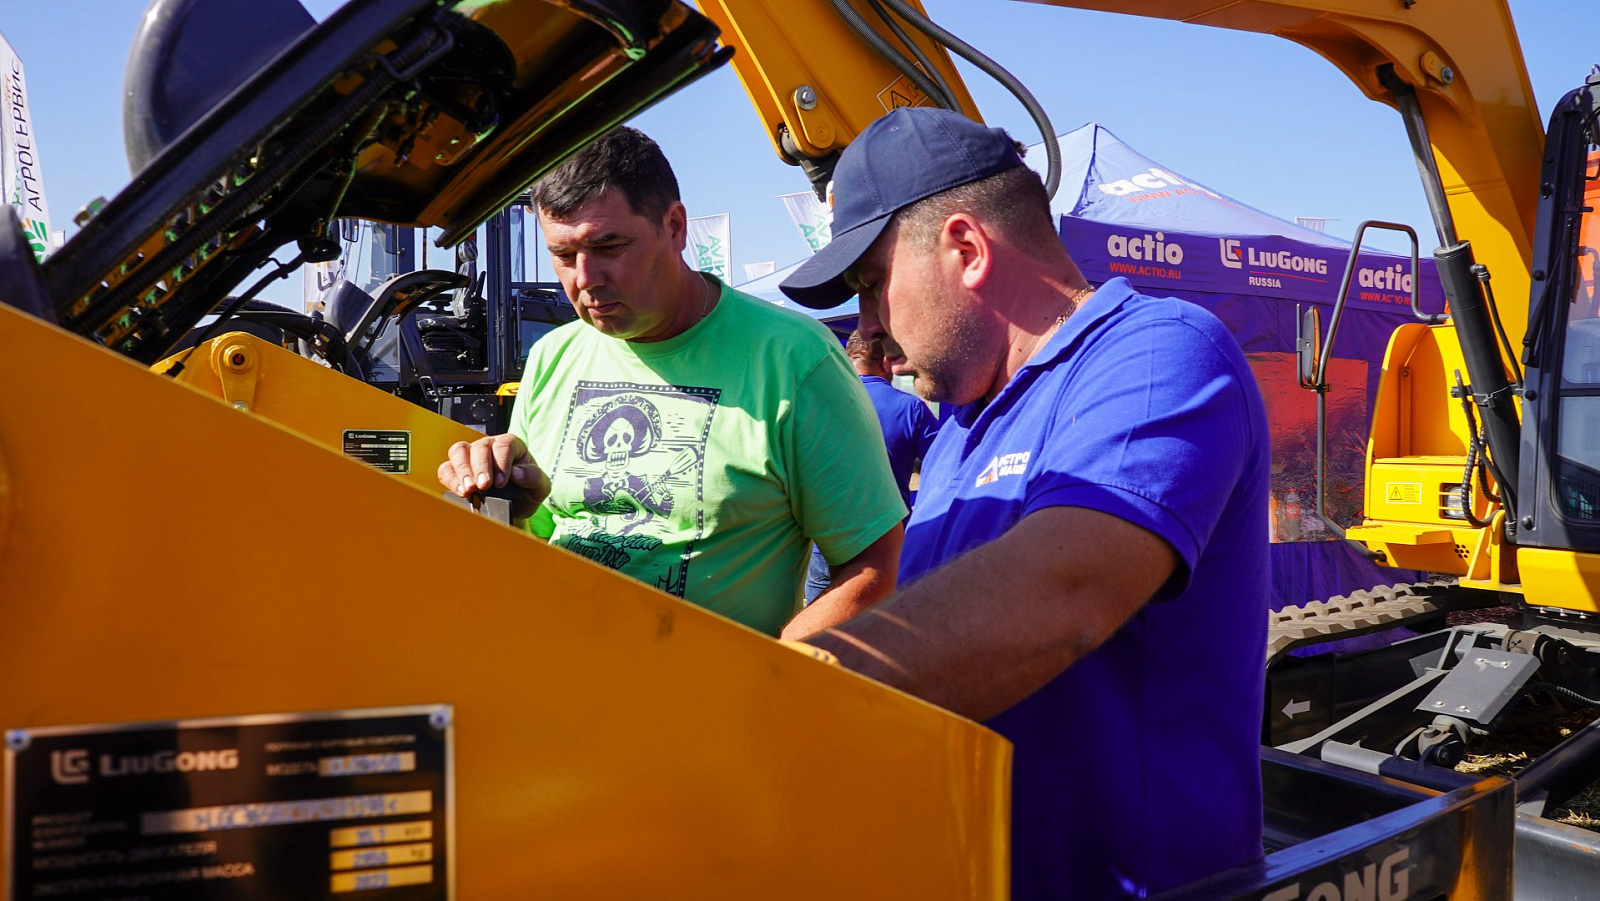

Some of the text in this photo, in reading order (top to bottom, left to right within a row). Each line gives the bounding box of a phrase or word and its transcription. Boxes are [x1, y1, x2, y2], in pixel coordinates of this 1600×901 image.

[1107, 231, 1184, 266] actio
[1109, 262, 1182, 280] WWW.ACTIO.RU
[1249, 276, 1282, 288] RUSSIA
[1358, 263, 1412, 293] actio
